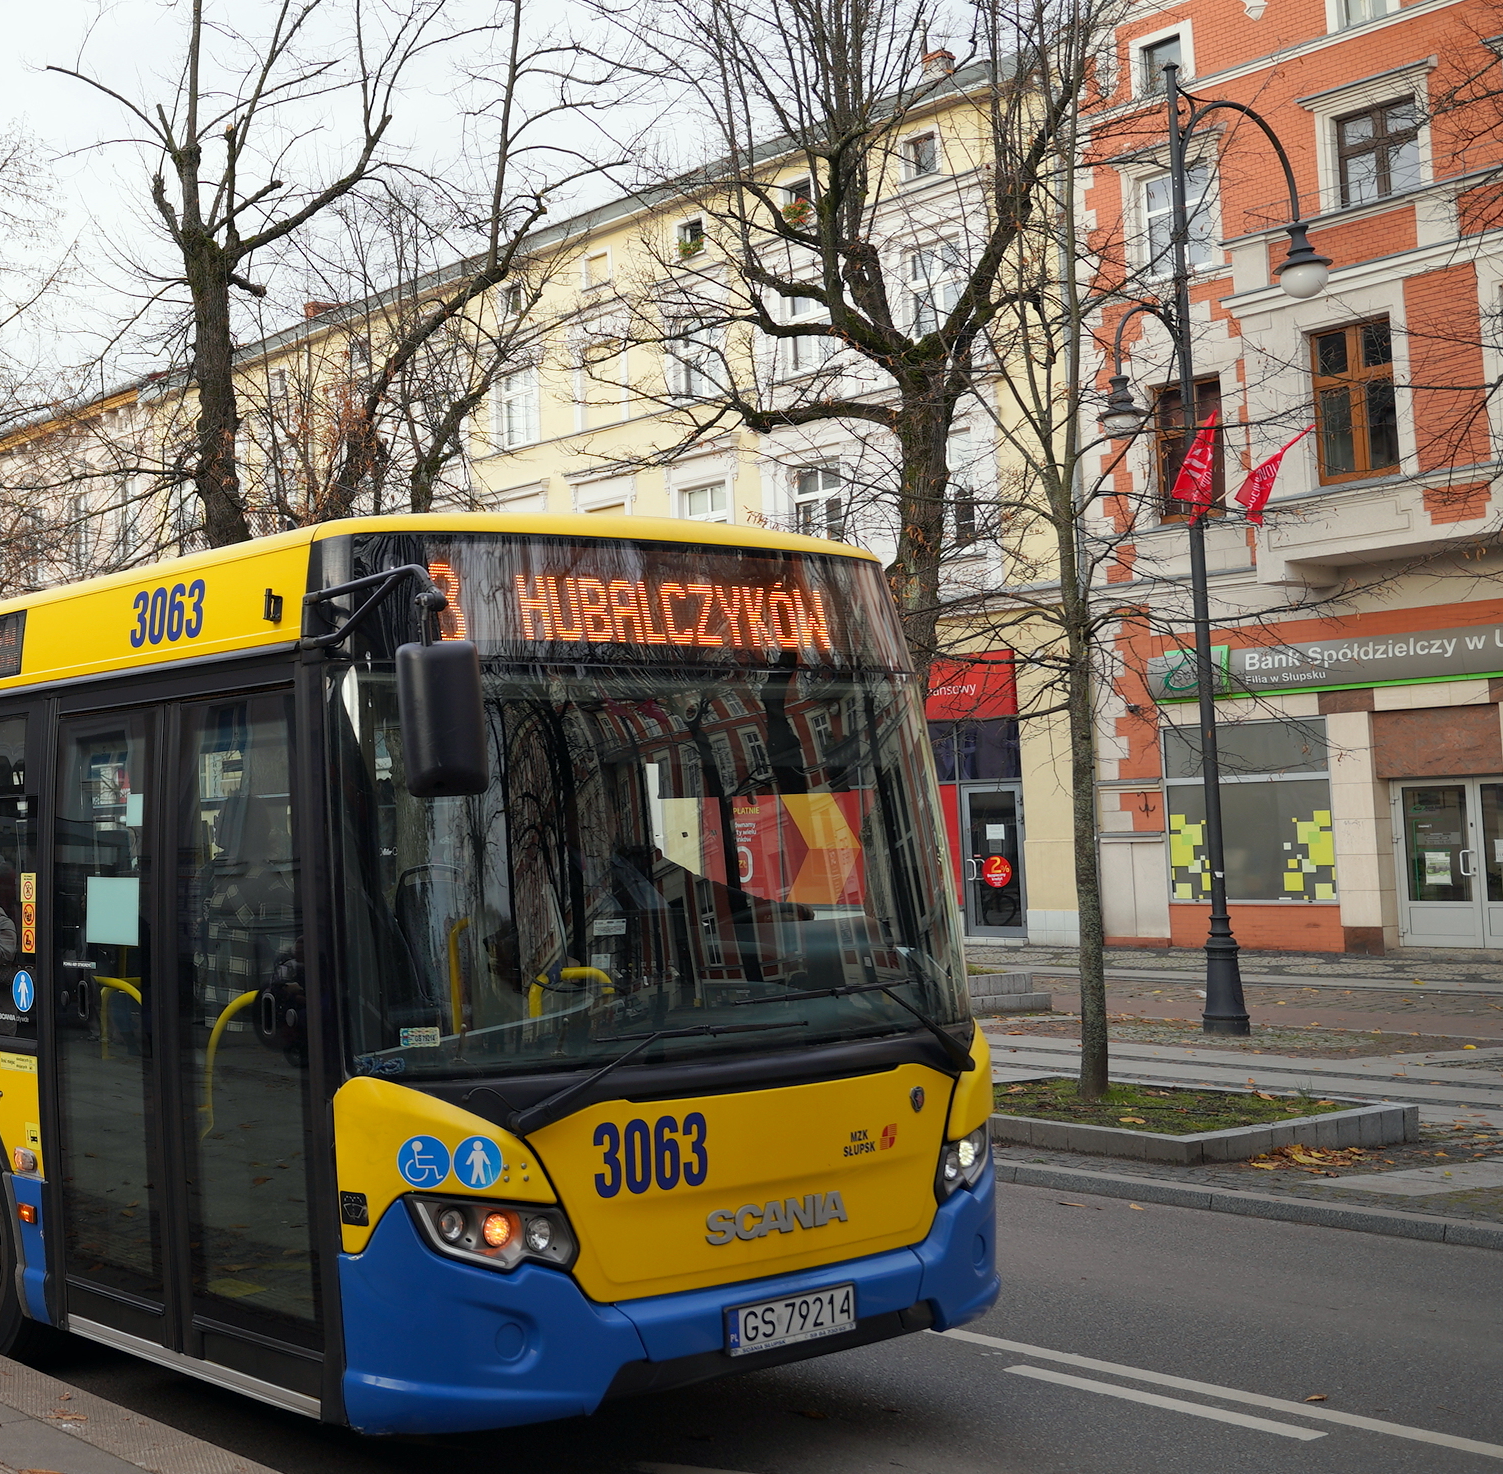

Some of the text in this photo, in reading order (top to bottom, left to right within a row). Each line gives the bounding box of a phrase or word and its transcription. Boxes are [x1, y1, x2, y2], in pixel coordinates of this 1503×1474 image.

[130, 578, 206, 649] 3063
[514, 573, 832, 650] HUBALCZYKÓW
[1244, 648, 1303, 672] Bank
[1307, 635, 1458, 666] Spółdzielczy
[1464, 634, 1487, 651] w
[1245, 669, 1327, 686] Filia w Słupsku
[592, 1111, 708, 1199] 3063
[843, 1141, 876, 1157] SŁUPSK
[850, 1129, 869, 1143] MZK
[705, 1190, 848, 1246] SCANIA
[729, 1333, 739, 1343] PL
[743, 1289, 851, 1342] GS 79214
